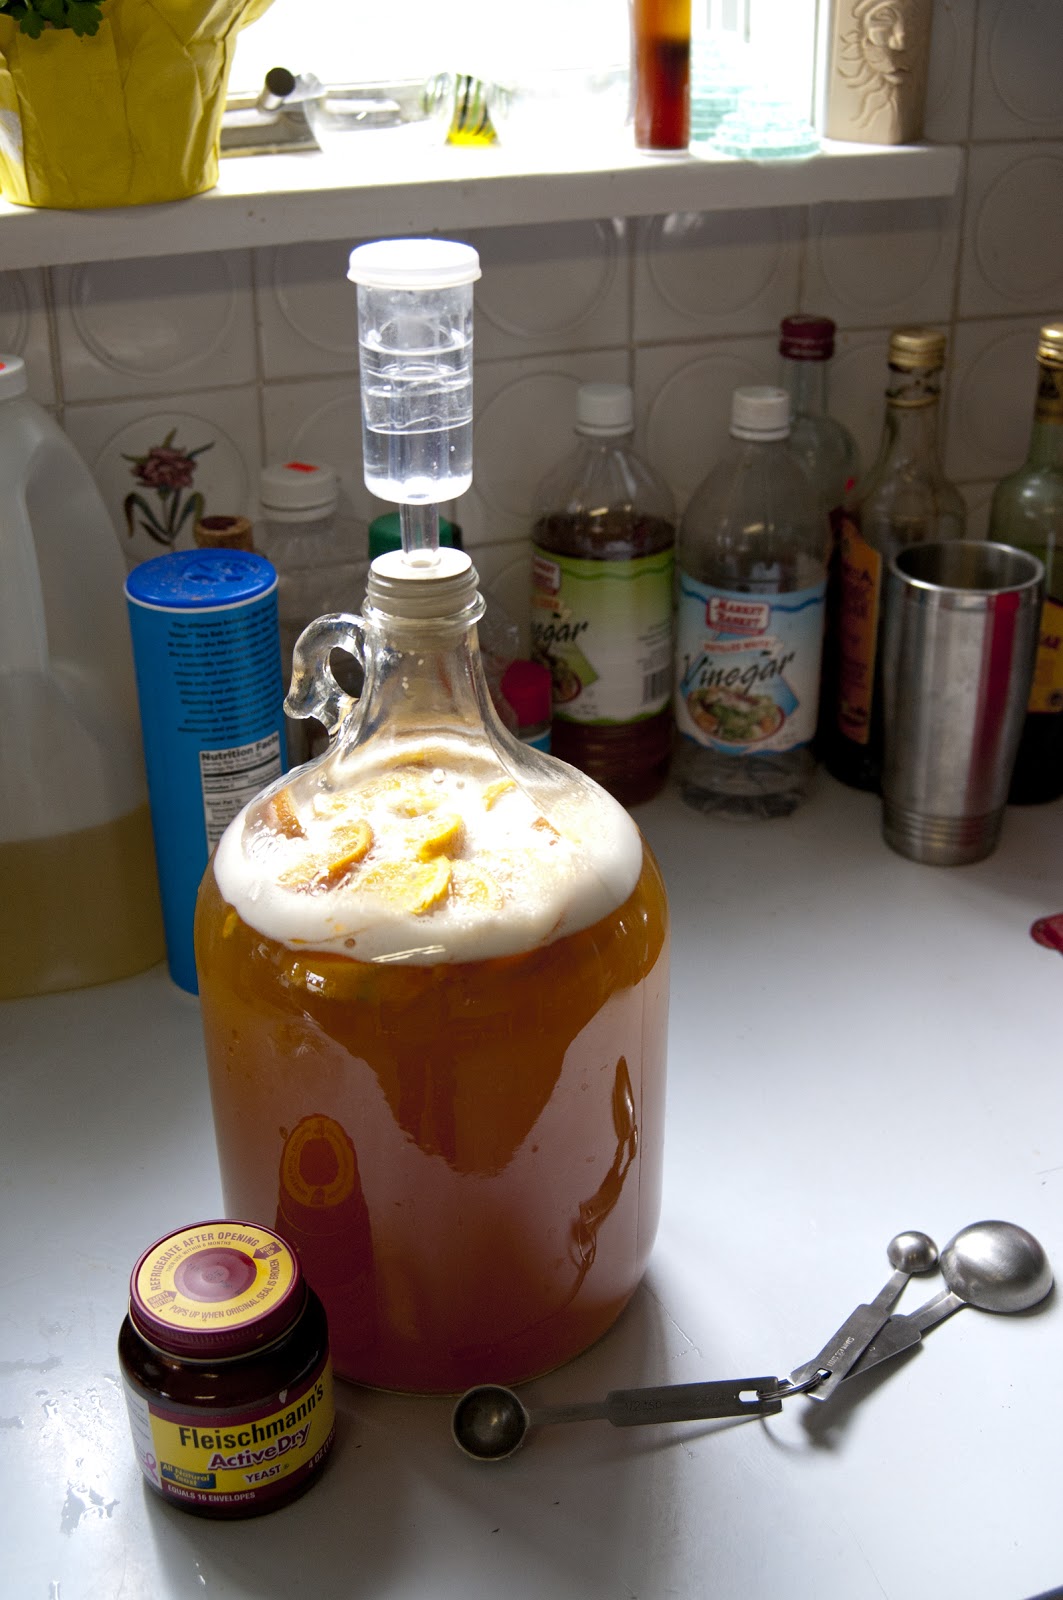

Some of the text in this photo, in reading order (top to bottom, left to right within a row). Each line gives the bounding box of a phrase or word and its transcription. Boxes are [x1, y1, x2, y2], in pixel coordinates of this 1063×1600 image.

[683, 651, 796, 694] Vinegar
[201, 747, 254, 761] Nutrition
[150, 1243, 183, 1292] REFRIGERATE
[182, 1232, 215, 1248] AFTER
[217, 1231, 260, 1247] OPENING
[169, 1258, 281, 1319] POPS UP WHEN ORIGINAL SEAL IS BROKEN
[178, 1383, 324, 1450] Fleischmann's
[163, 1463, 210, 1482] All Natural
[245, 1464, 281, 1484] YEAST
[167, 1484, 256, 1503] EQUALS 16 ENVELOPES
